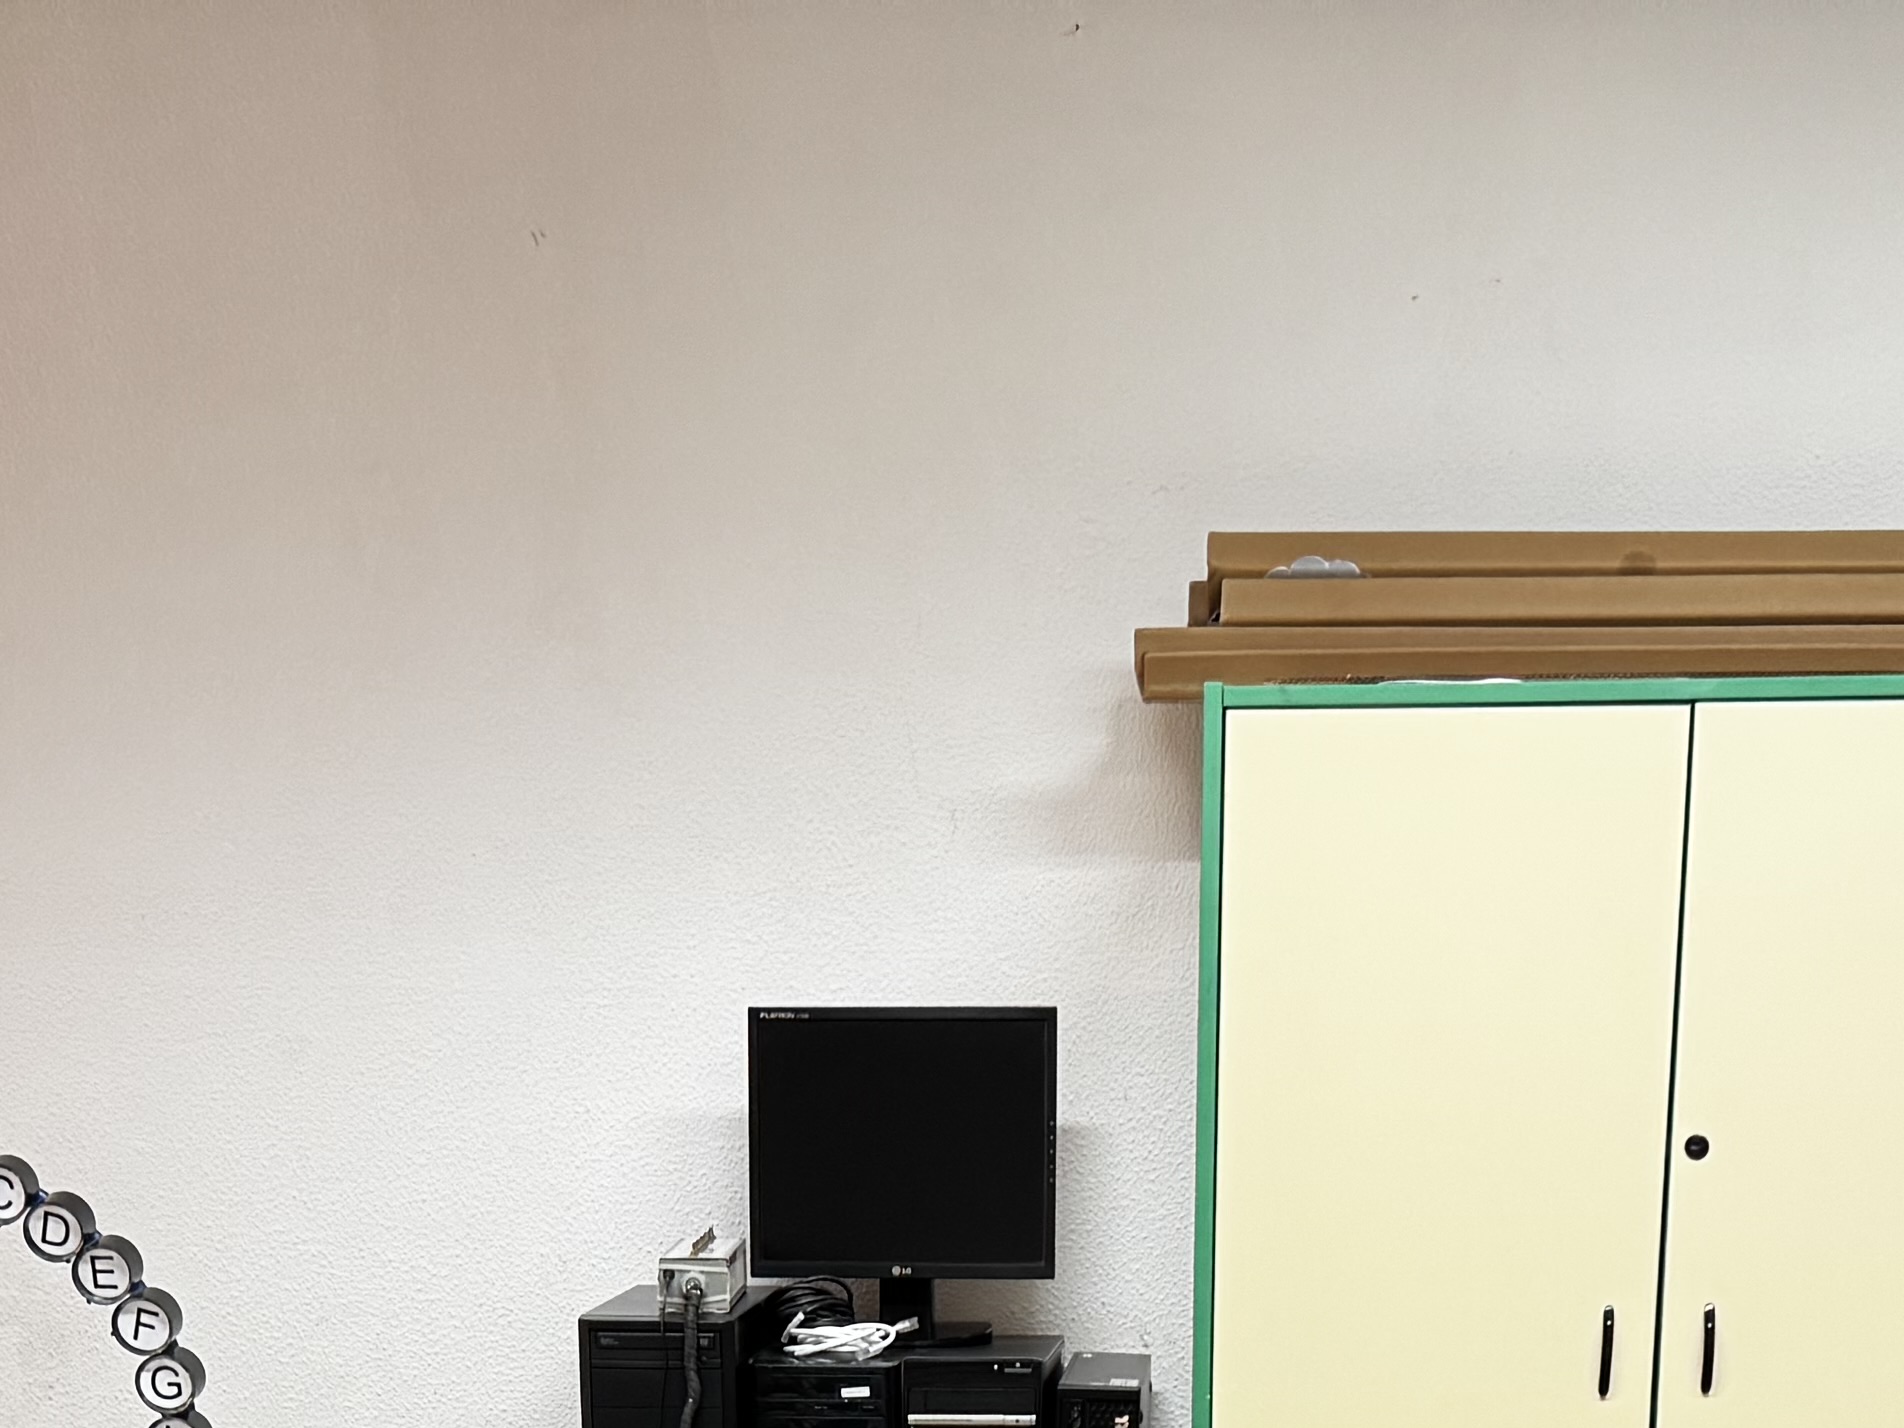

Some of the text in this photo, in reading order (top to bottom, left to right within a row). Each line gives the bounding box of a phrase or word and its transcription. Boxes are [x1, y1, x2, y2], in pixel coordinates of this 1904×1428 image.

[40, 1210, 71, 1247] D
[89, 1254, 119, 1290] E
[132, 1306, 160, 1341] F
[150, 1365, 183, 1400] G
